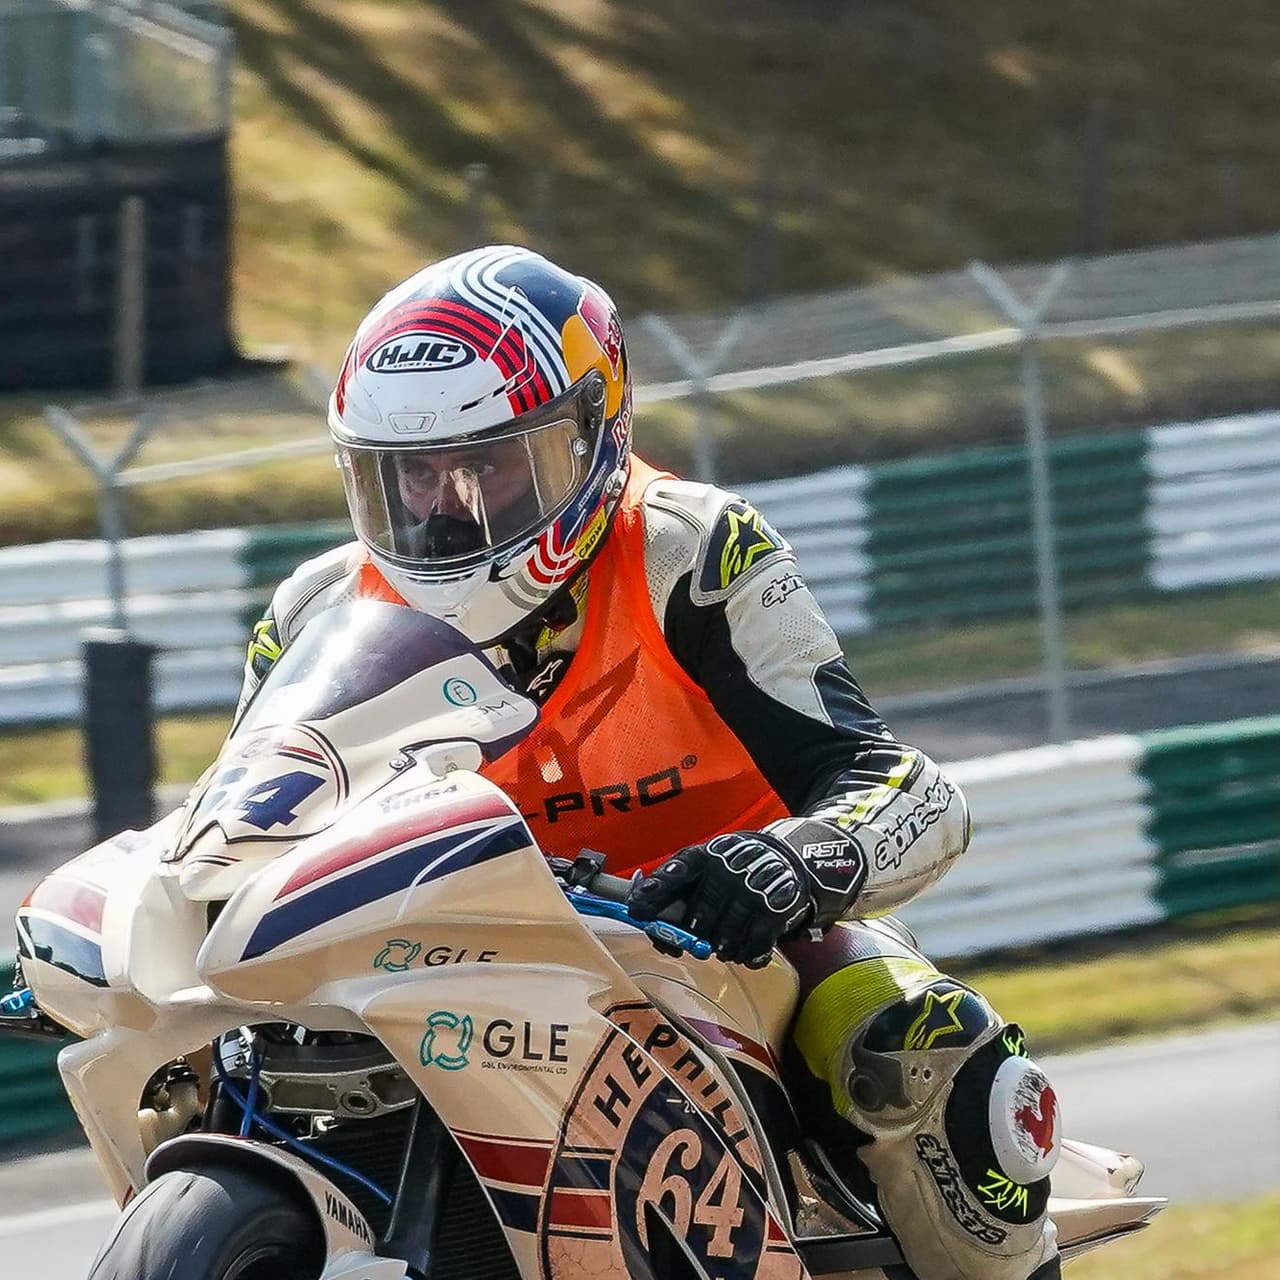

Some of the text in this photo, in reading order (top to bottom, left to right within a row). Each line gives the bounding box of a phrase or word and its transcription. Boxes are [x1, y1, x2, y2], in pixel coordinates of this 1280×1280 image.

[376, 342, 461, 368] HJC
[802, 840, 850, 860] RST
[483, 1019, 569, 1062] GLE
[636, 1128, 744, 1257] 64
[325, 1191, 370, 1245] YAMAHA
